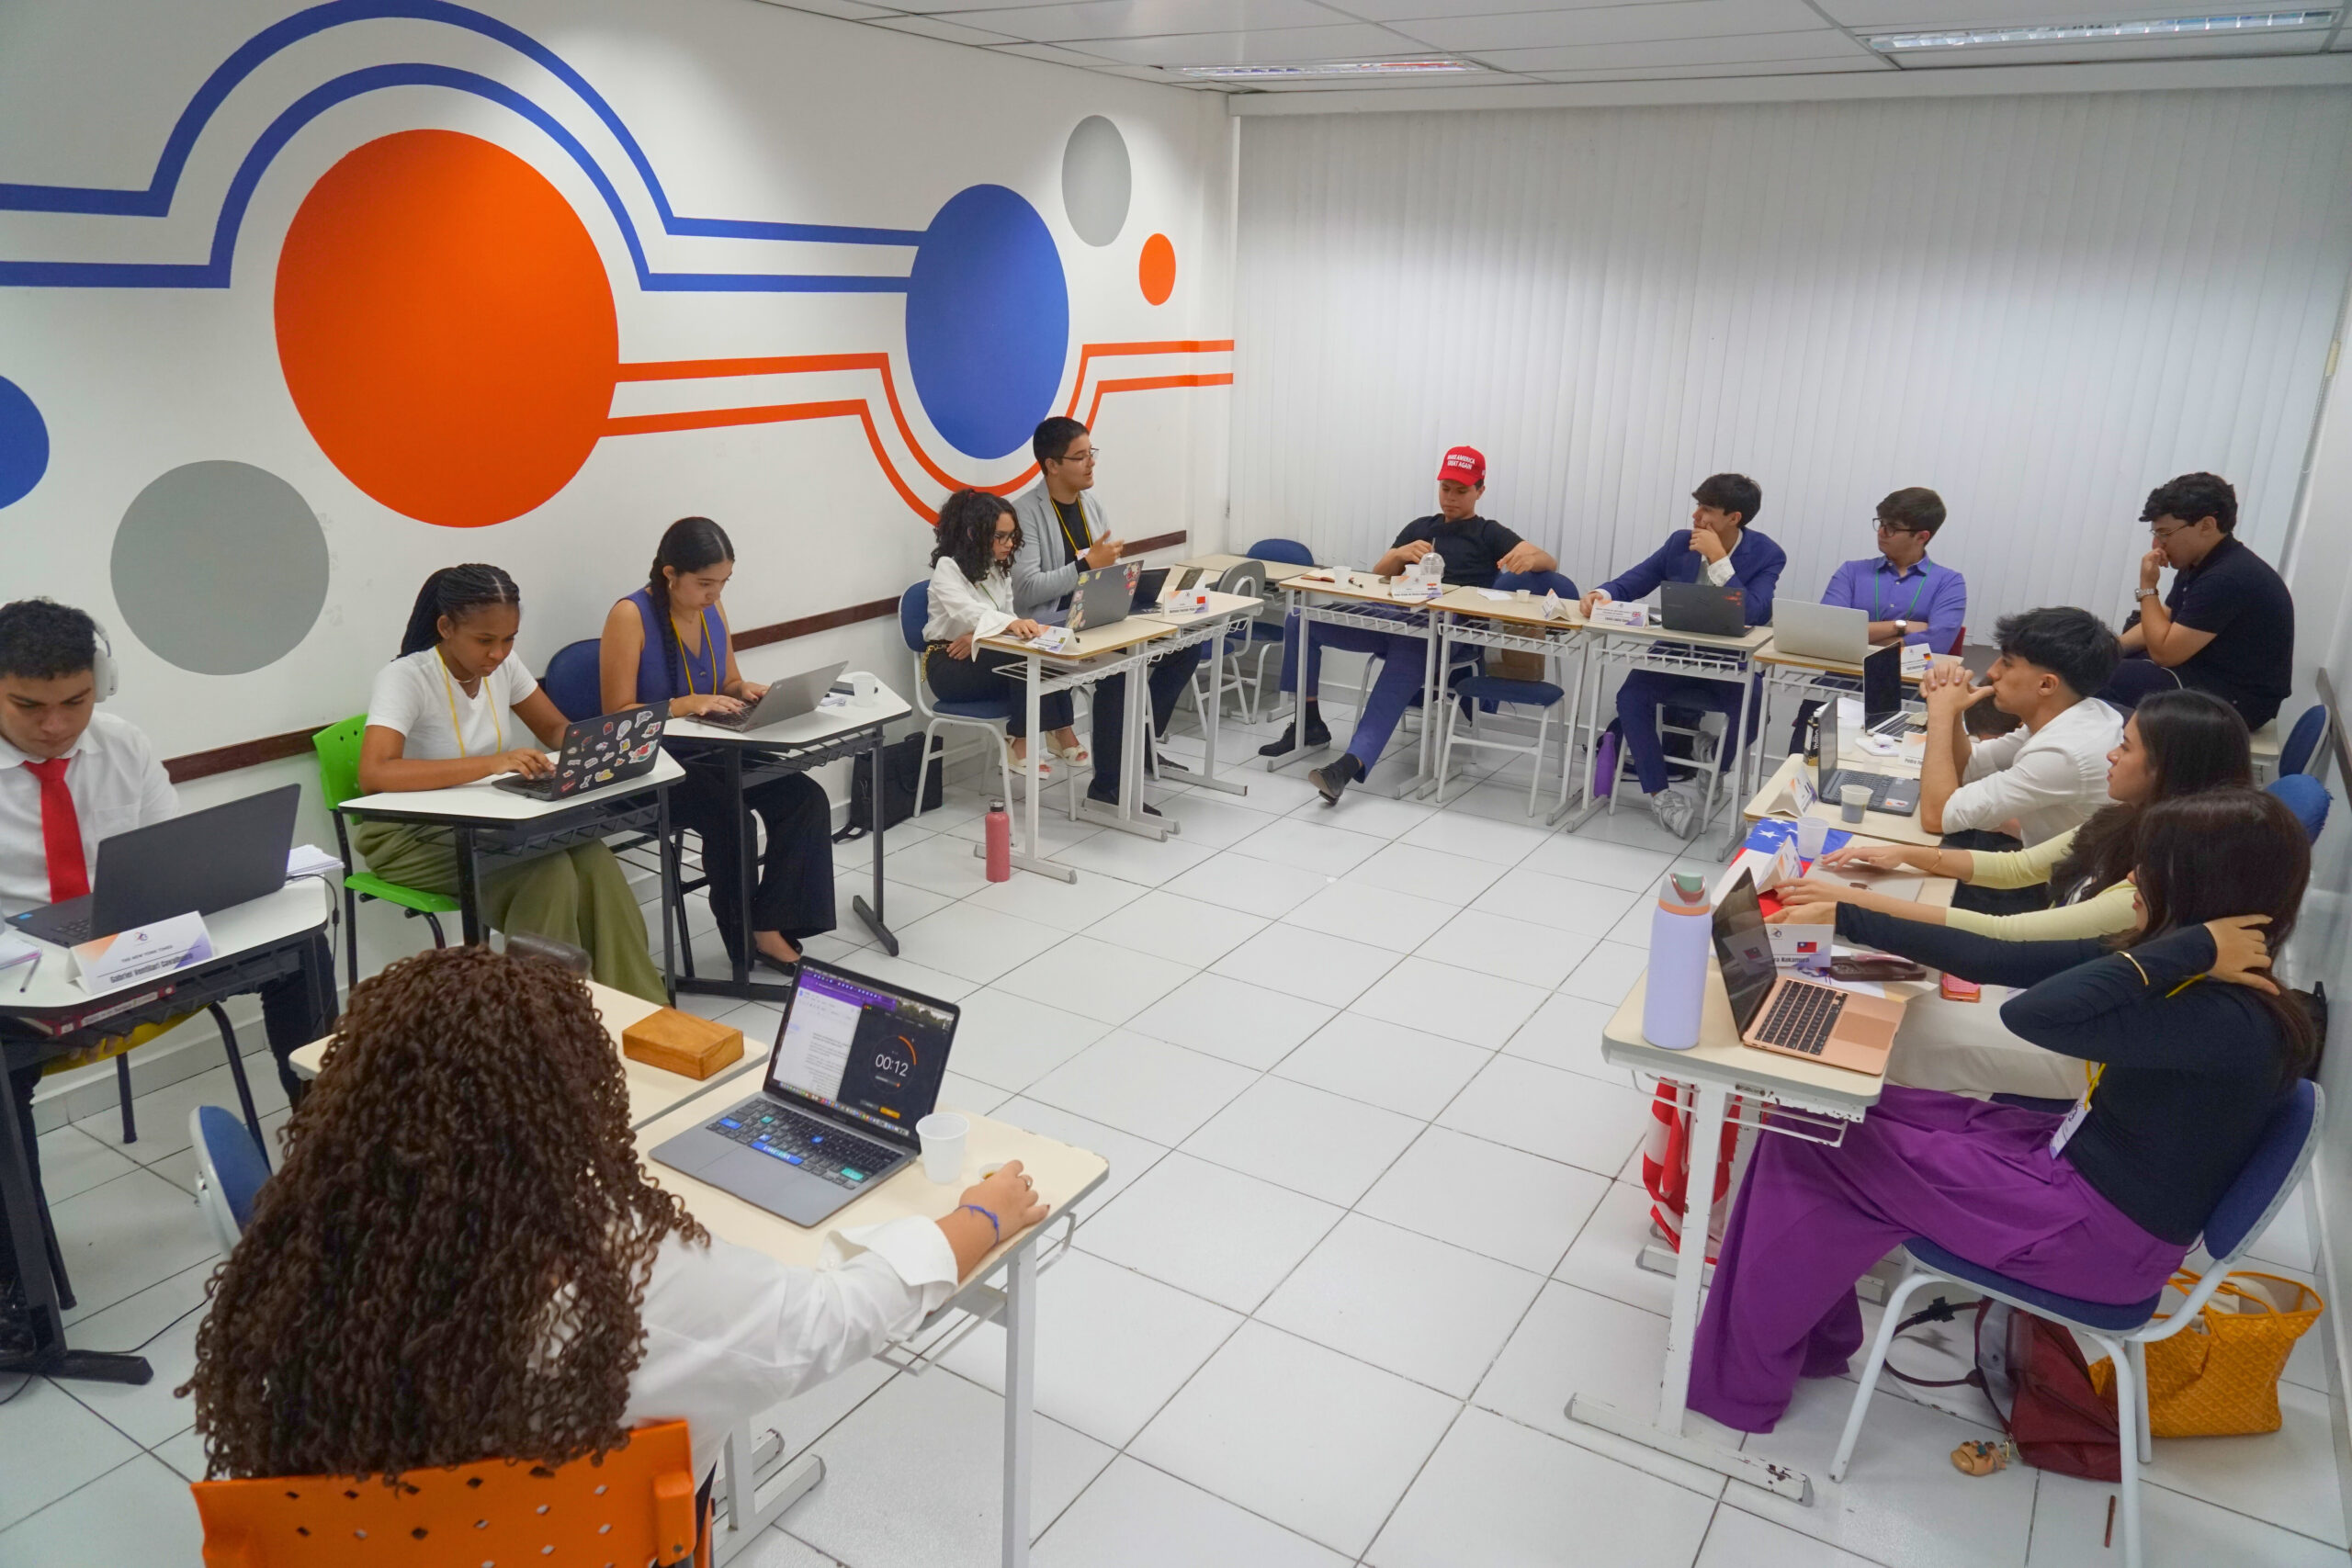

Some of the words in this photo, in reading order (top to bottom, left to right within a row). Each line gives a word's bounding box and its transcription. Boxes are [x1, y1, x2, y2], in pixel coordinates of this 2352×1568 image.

[1458, 461, 1472, 469] AGAIN
[110, 971, 132, 983] Gabriel
[876, 1054, 909, 1077] 00:12
